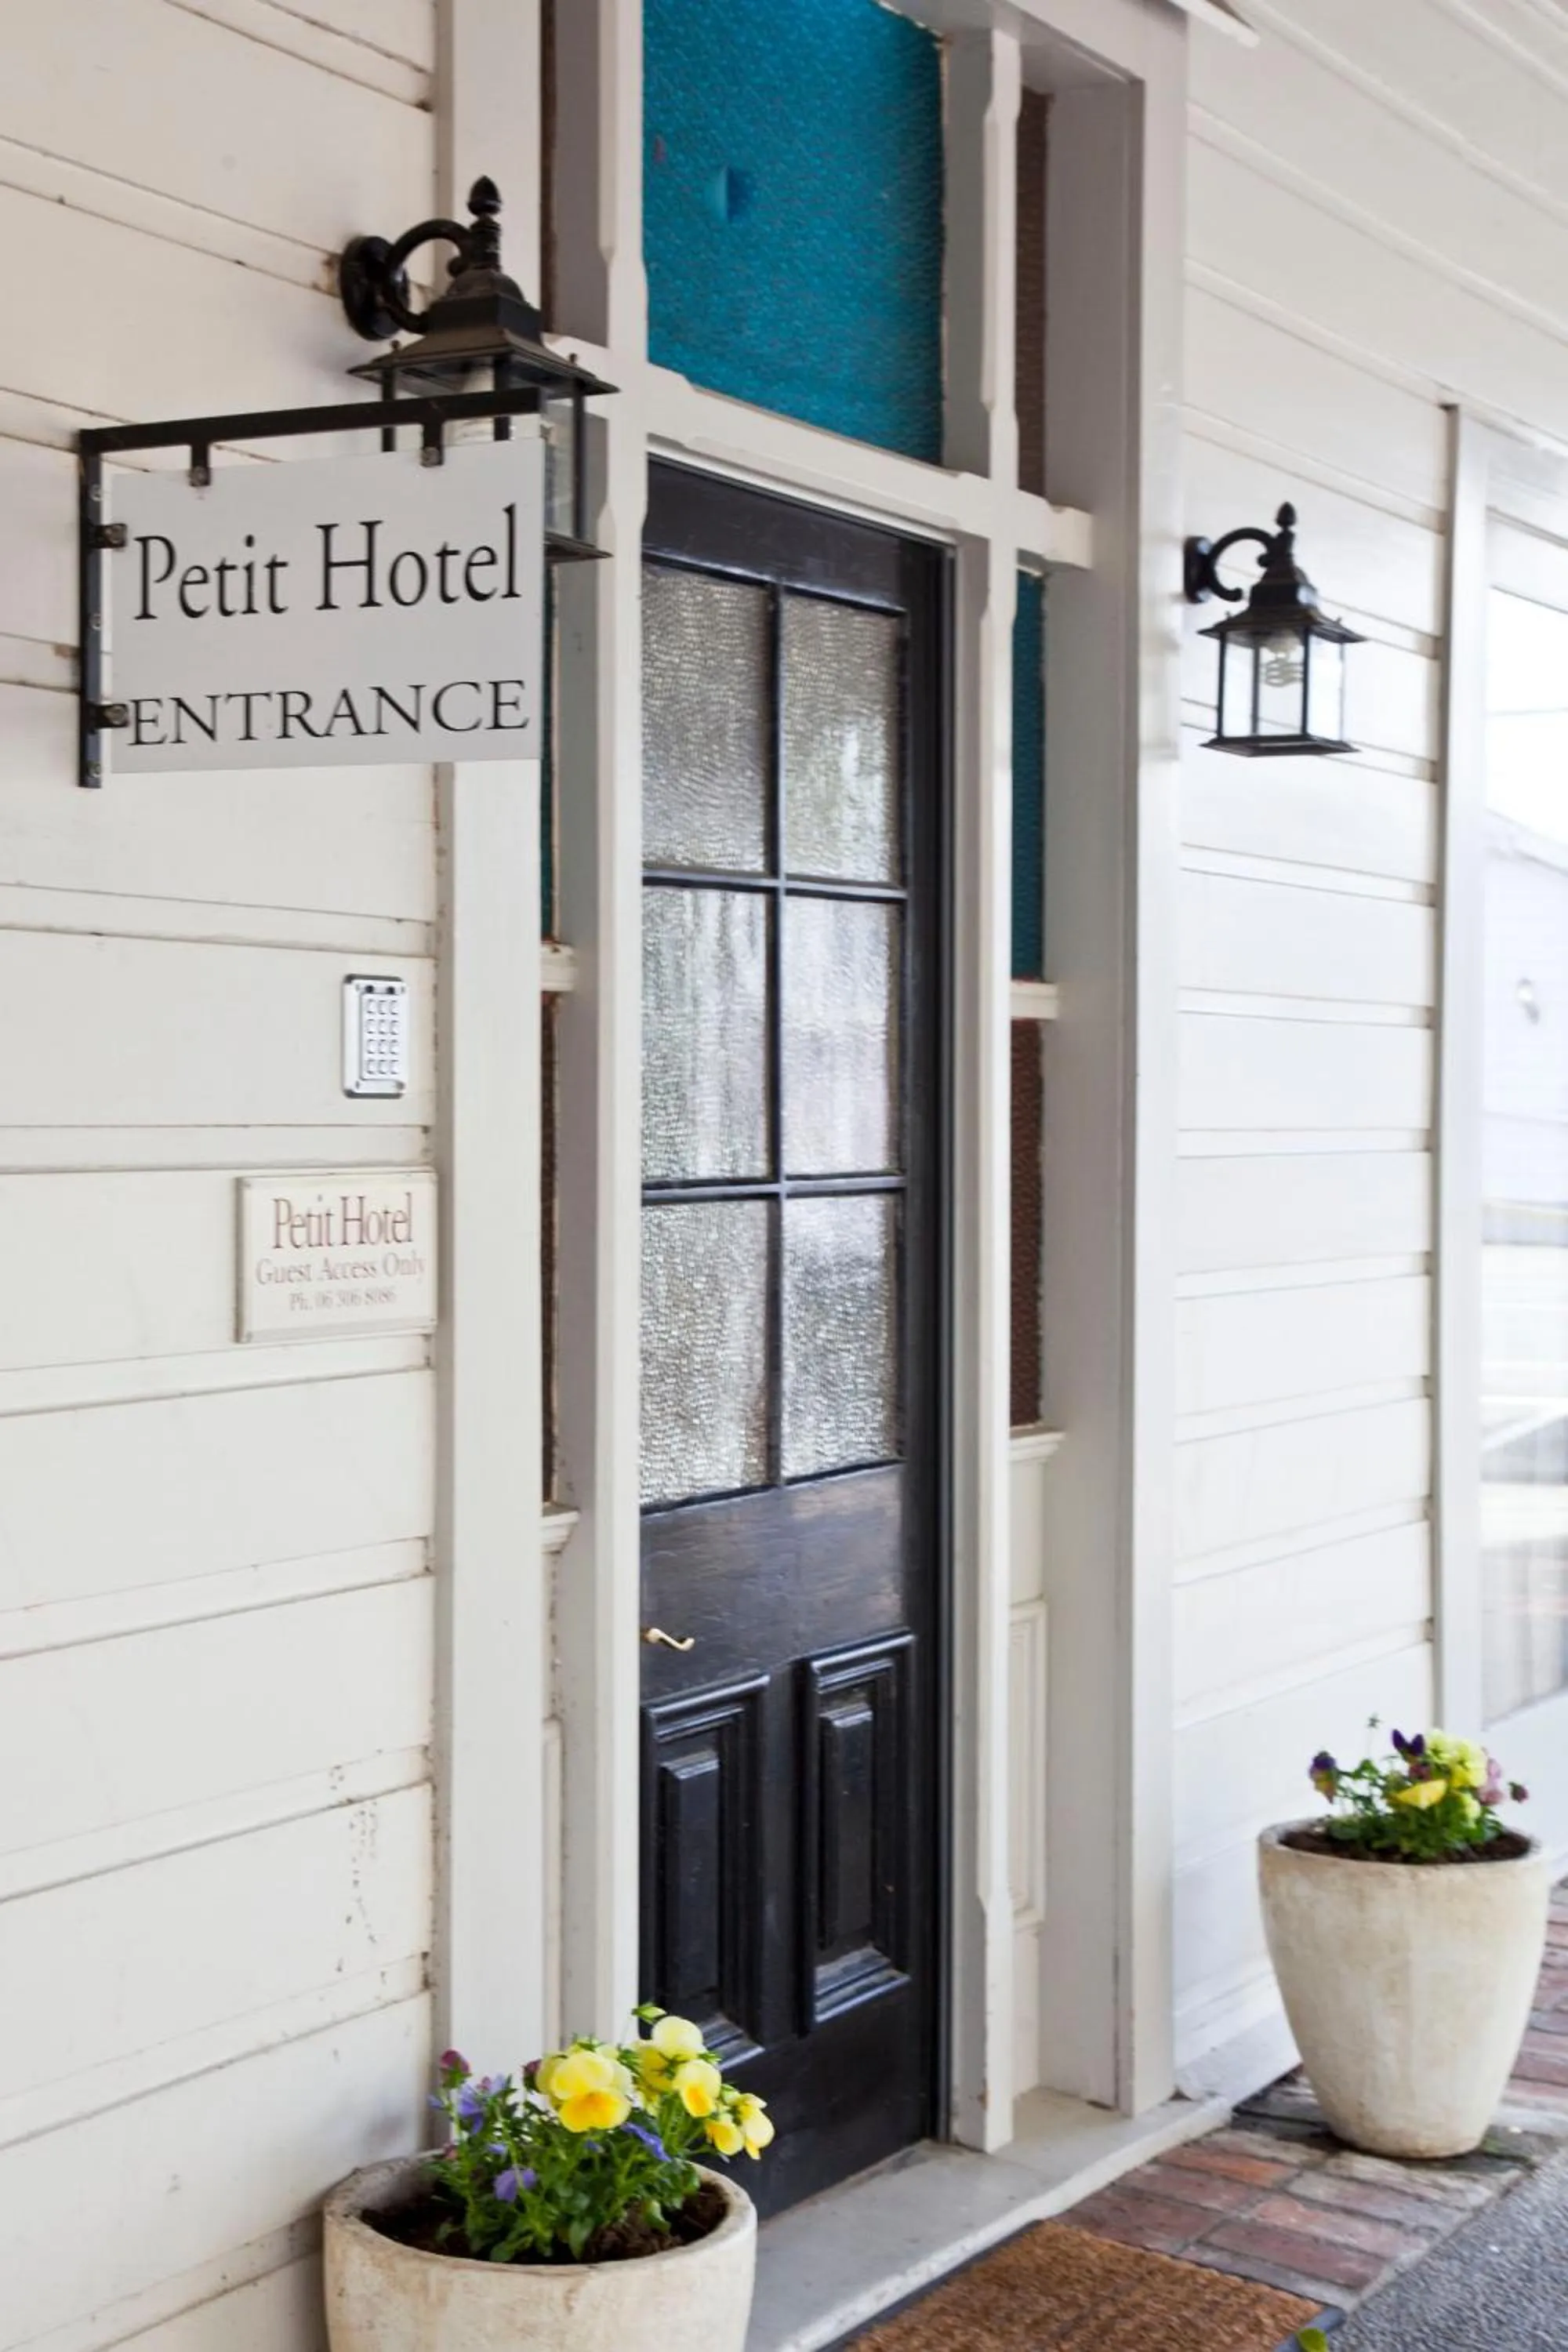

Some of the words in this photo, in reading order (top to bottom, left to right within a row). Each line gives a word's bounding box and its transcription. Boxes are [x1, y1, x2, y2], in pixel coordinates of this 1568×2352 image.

[133, 534, 289, 619] Petit
[314, 502, 521, 612] Hotel
[127, 679, 530, 746] ENTRANCE
[272, 1194, 333, 1249] Petit
[339, 1192, 413, 1245] Hotel
[256, 1258, 313, 1284] Guest
[317, 1257, 376, 1281] Access
[383, 1250, 425, 1284] Only
